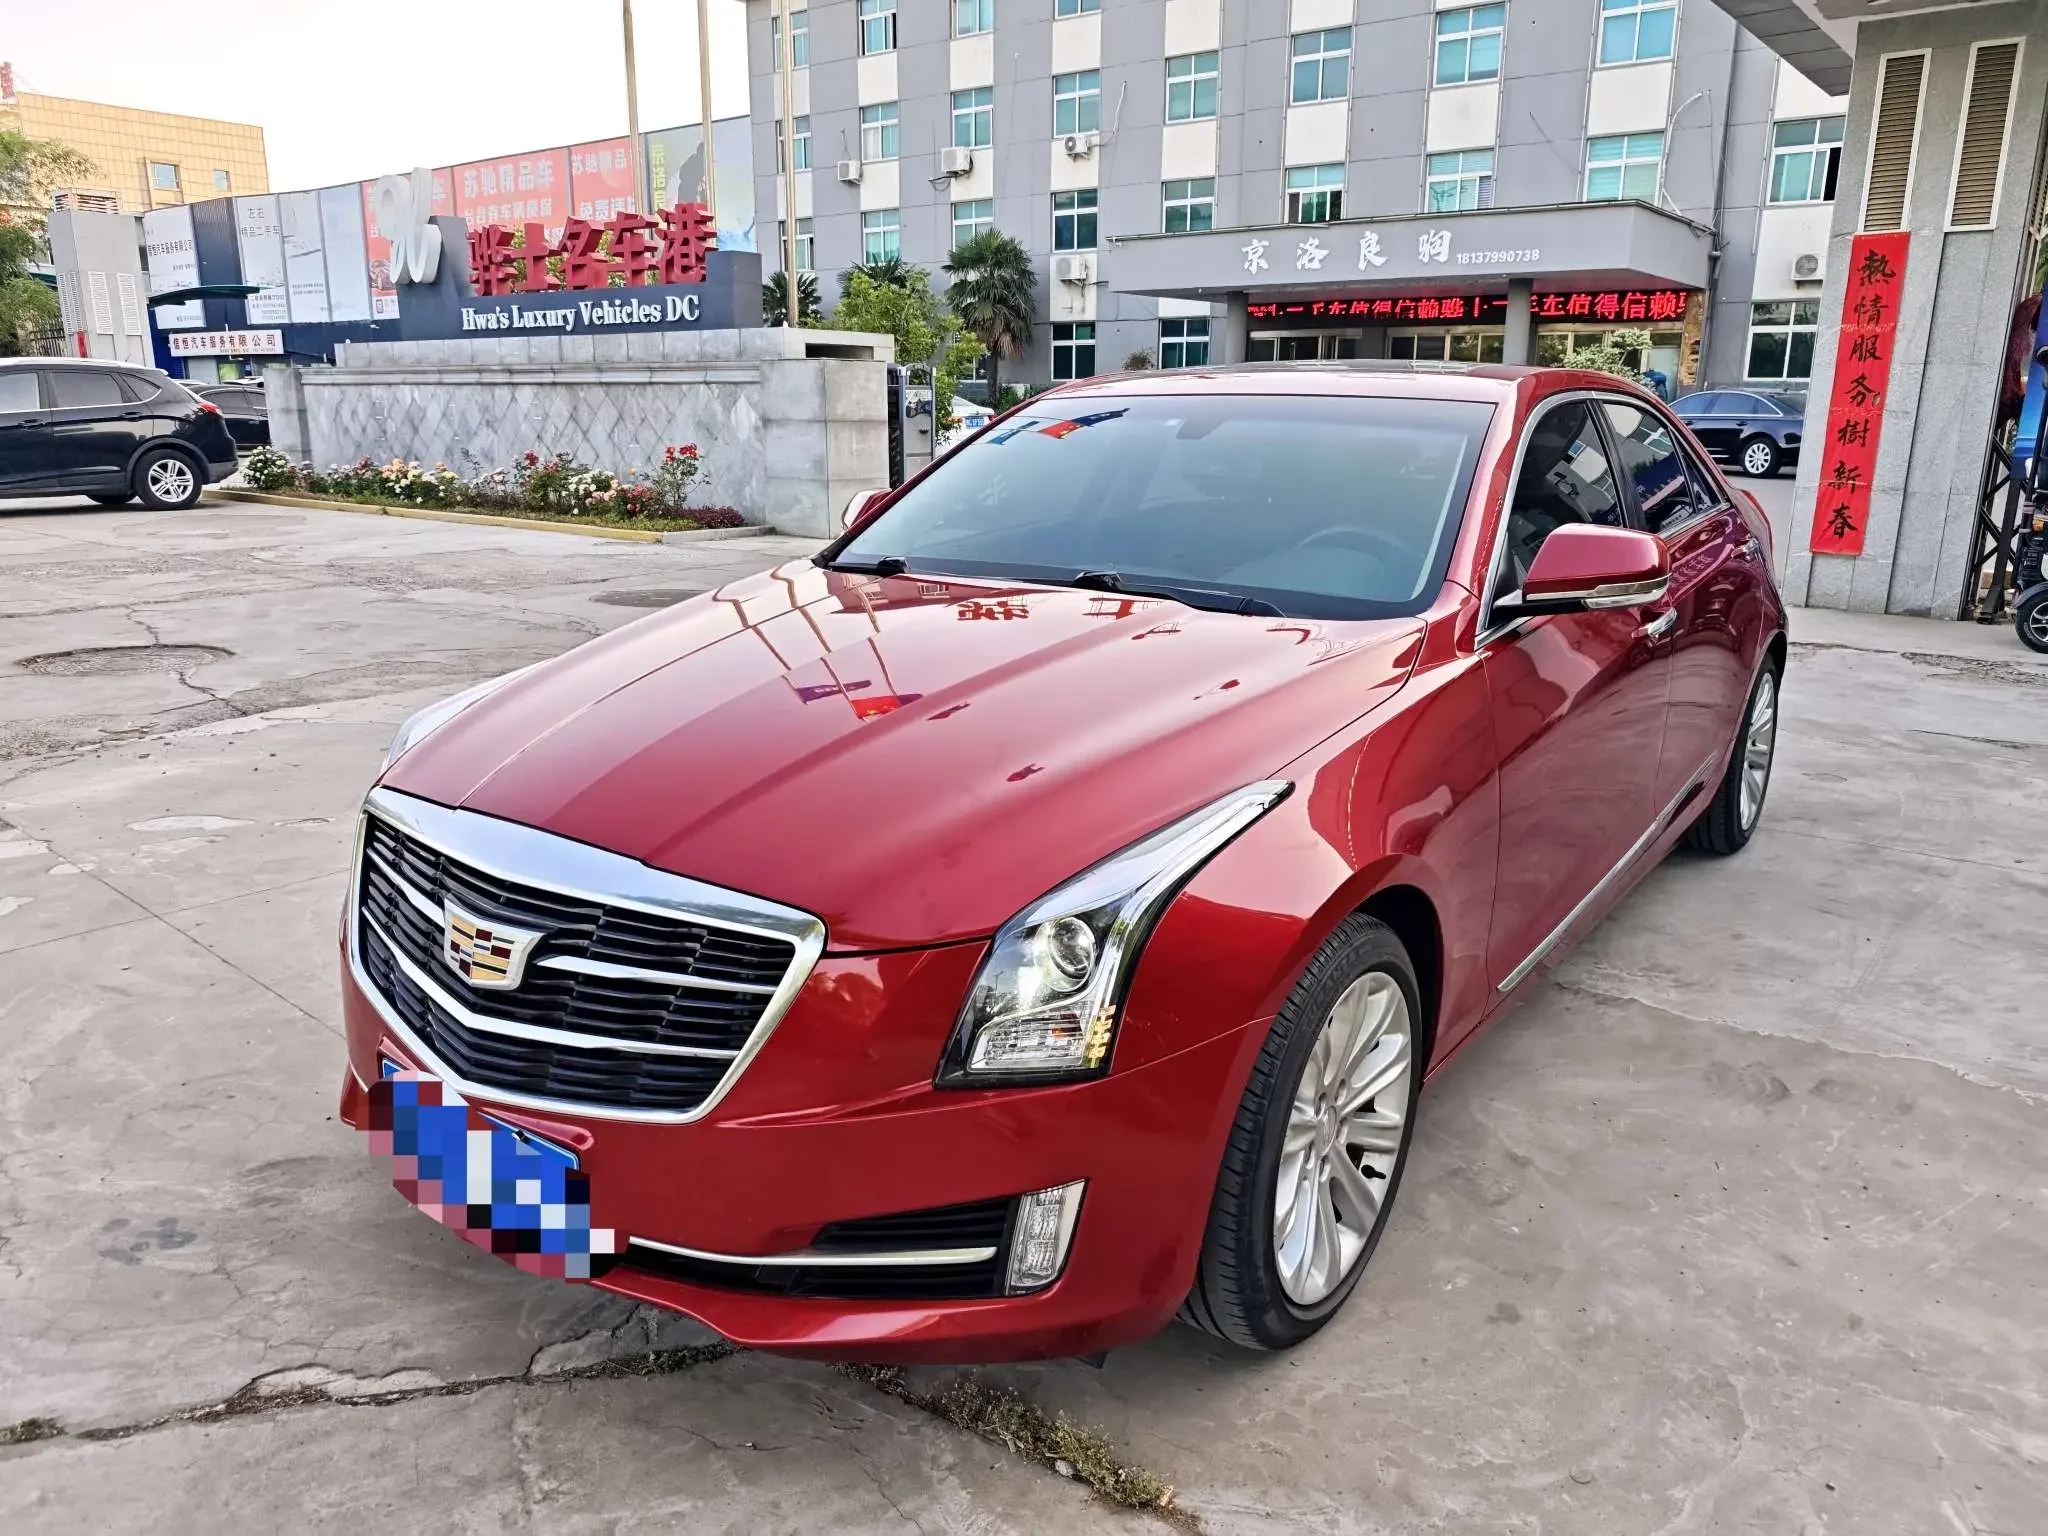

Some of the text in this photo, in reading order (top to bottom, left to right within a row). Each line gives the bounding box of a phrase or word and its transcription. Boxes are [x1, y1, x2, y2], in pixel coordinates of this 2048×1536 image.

[1455, 248, 1541, 265] 18137990738
[461, 294, 701, 332] Hwa's Luxury Vehicles DC
[173, 334, 276, 350] 信恒汽车服务有限公司
